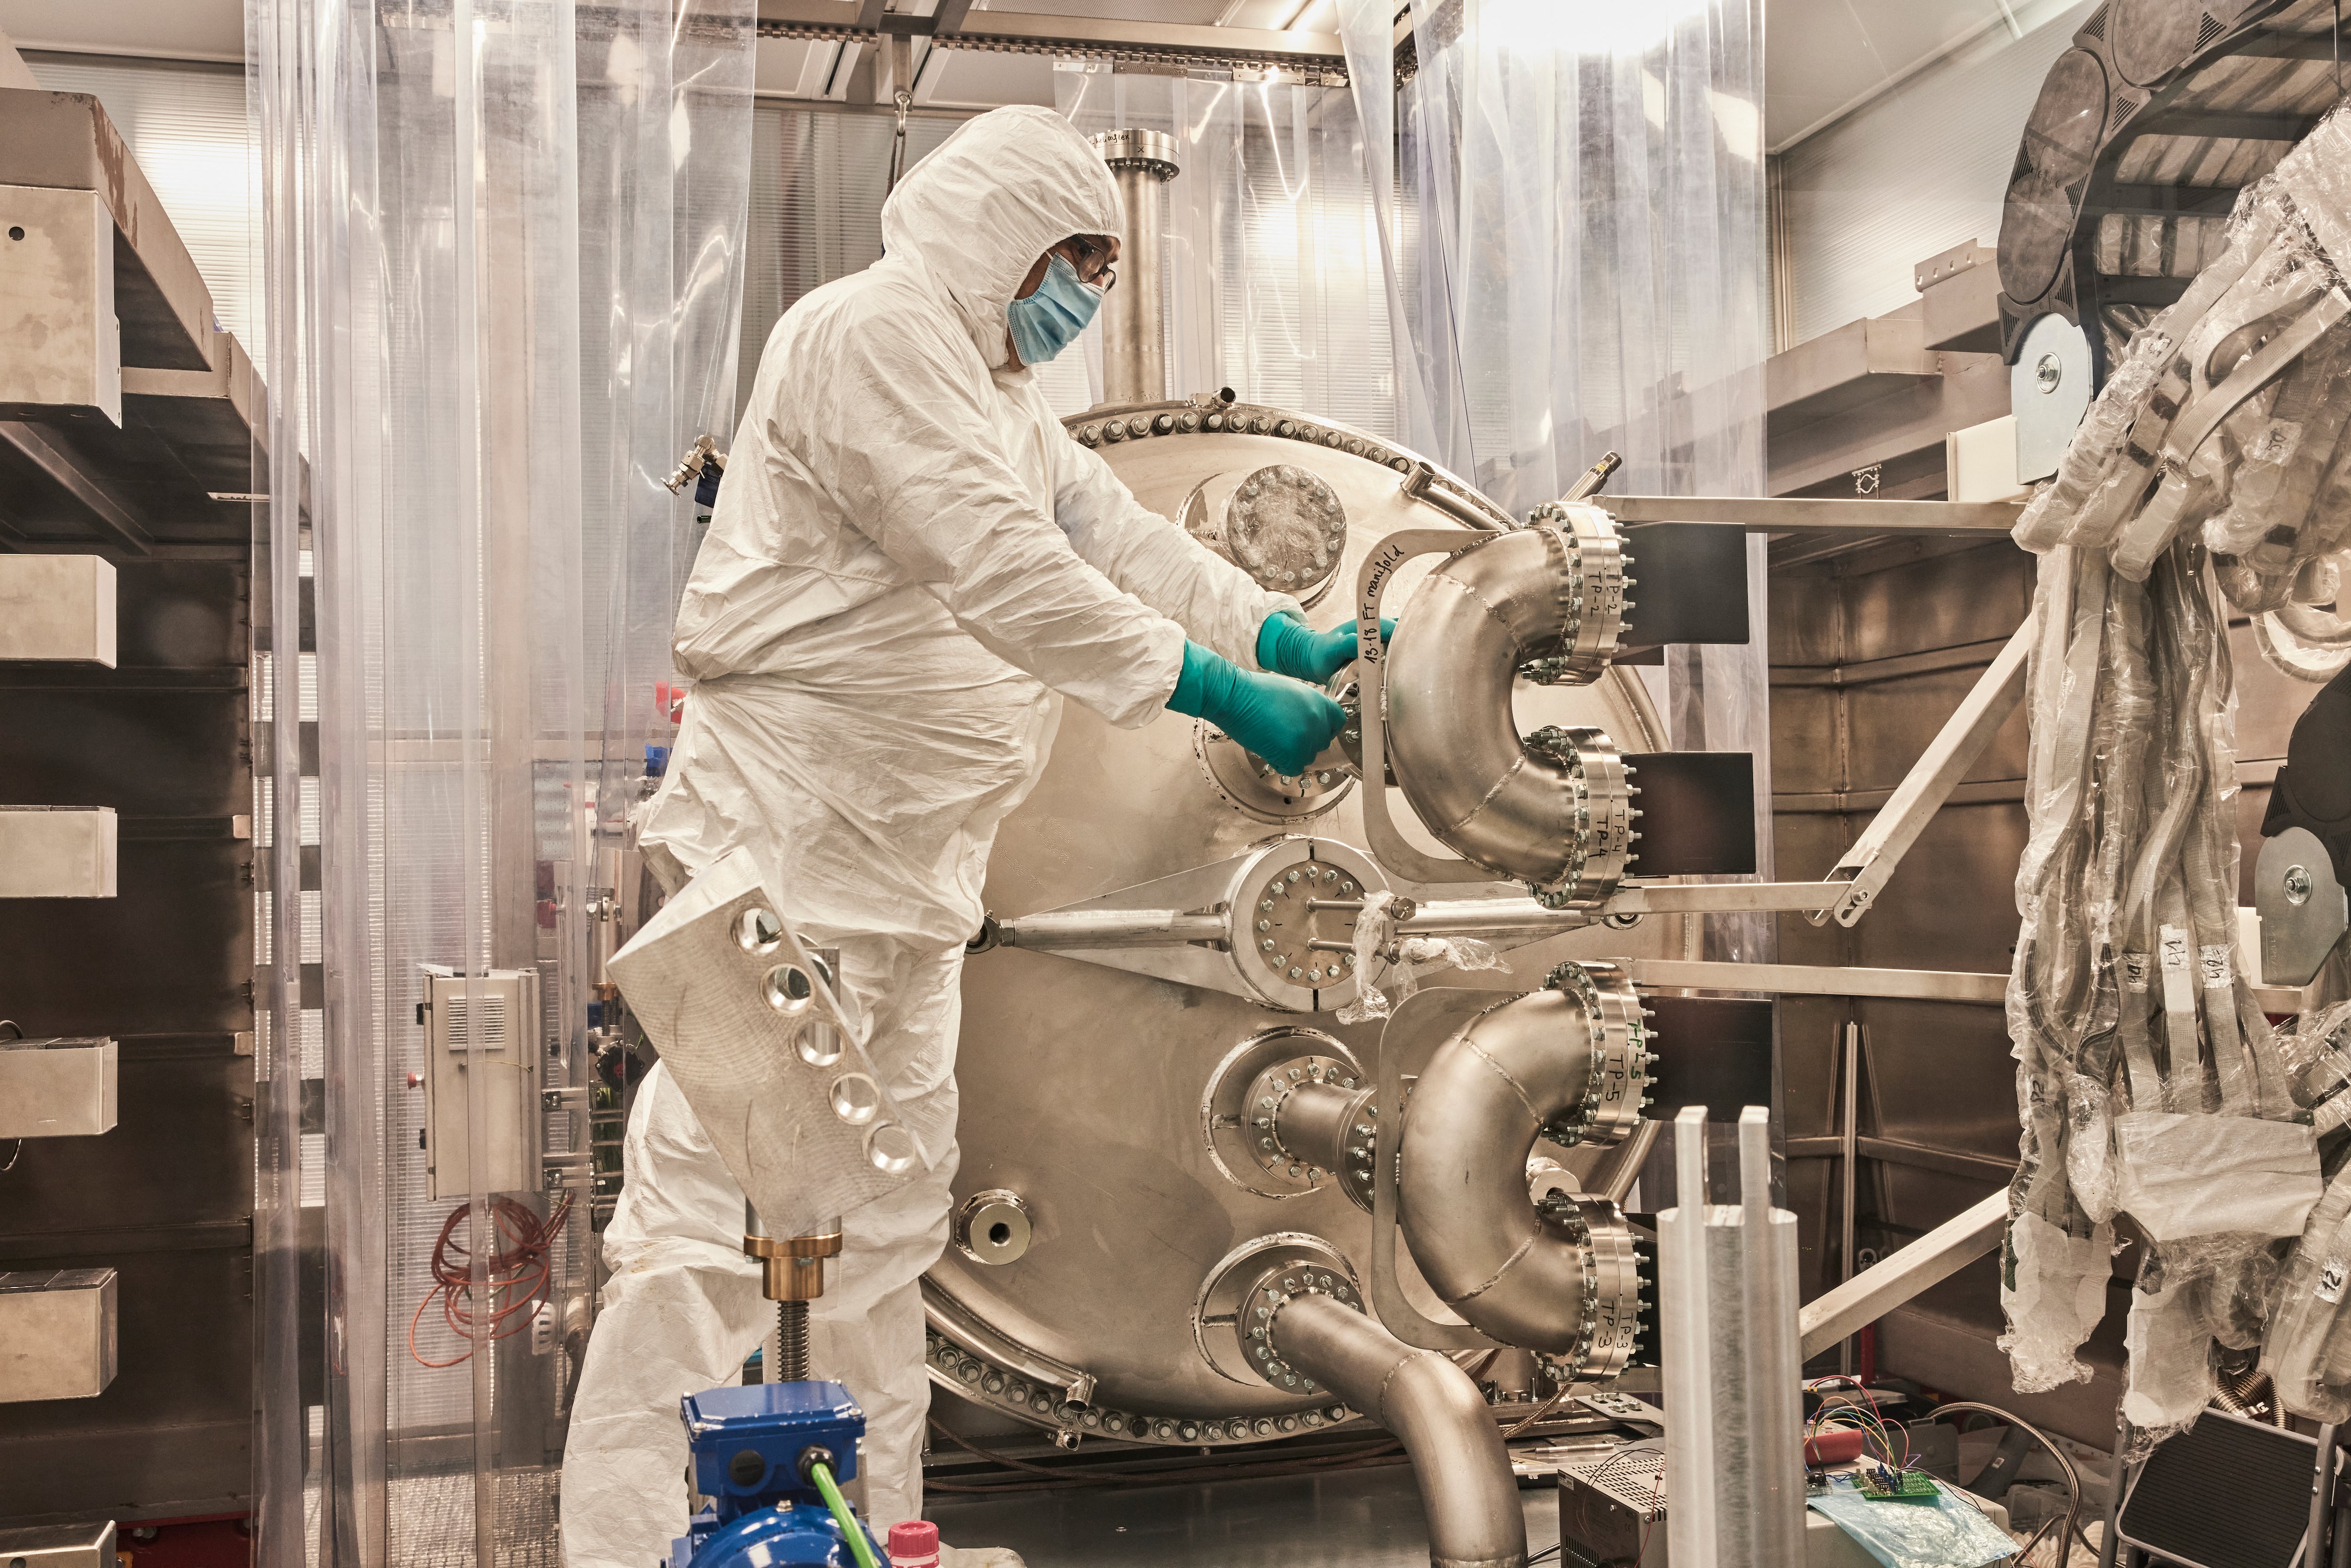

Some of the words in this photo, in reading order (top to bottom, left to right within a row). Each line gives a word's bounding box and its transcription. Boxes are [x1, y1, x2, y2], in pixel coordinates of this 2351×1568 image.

[1367, 544, 1404, 597] manifold
[1363, 604, 1378, 620] FT
[1589, 571, 1602, 616] TP-2
[1364, 628, 1378, 664] 13-18
[1592, 815, 1609, 858] TP-4
[1612, 809, 1625, 852] TP-4
[1606, 1054, 1624, 1102] TP-5
[2322, 1271, 2341, 1290] 12
[1598, 1300, 1615, 1348] TP-3
[1616, 1312, 1633, 1348] TP-3
